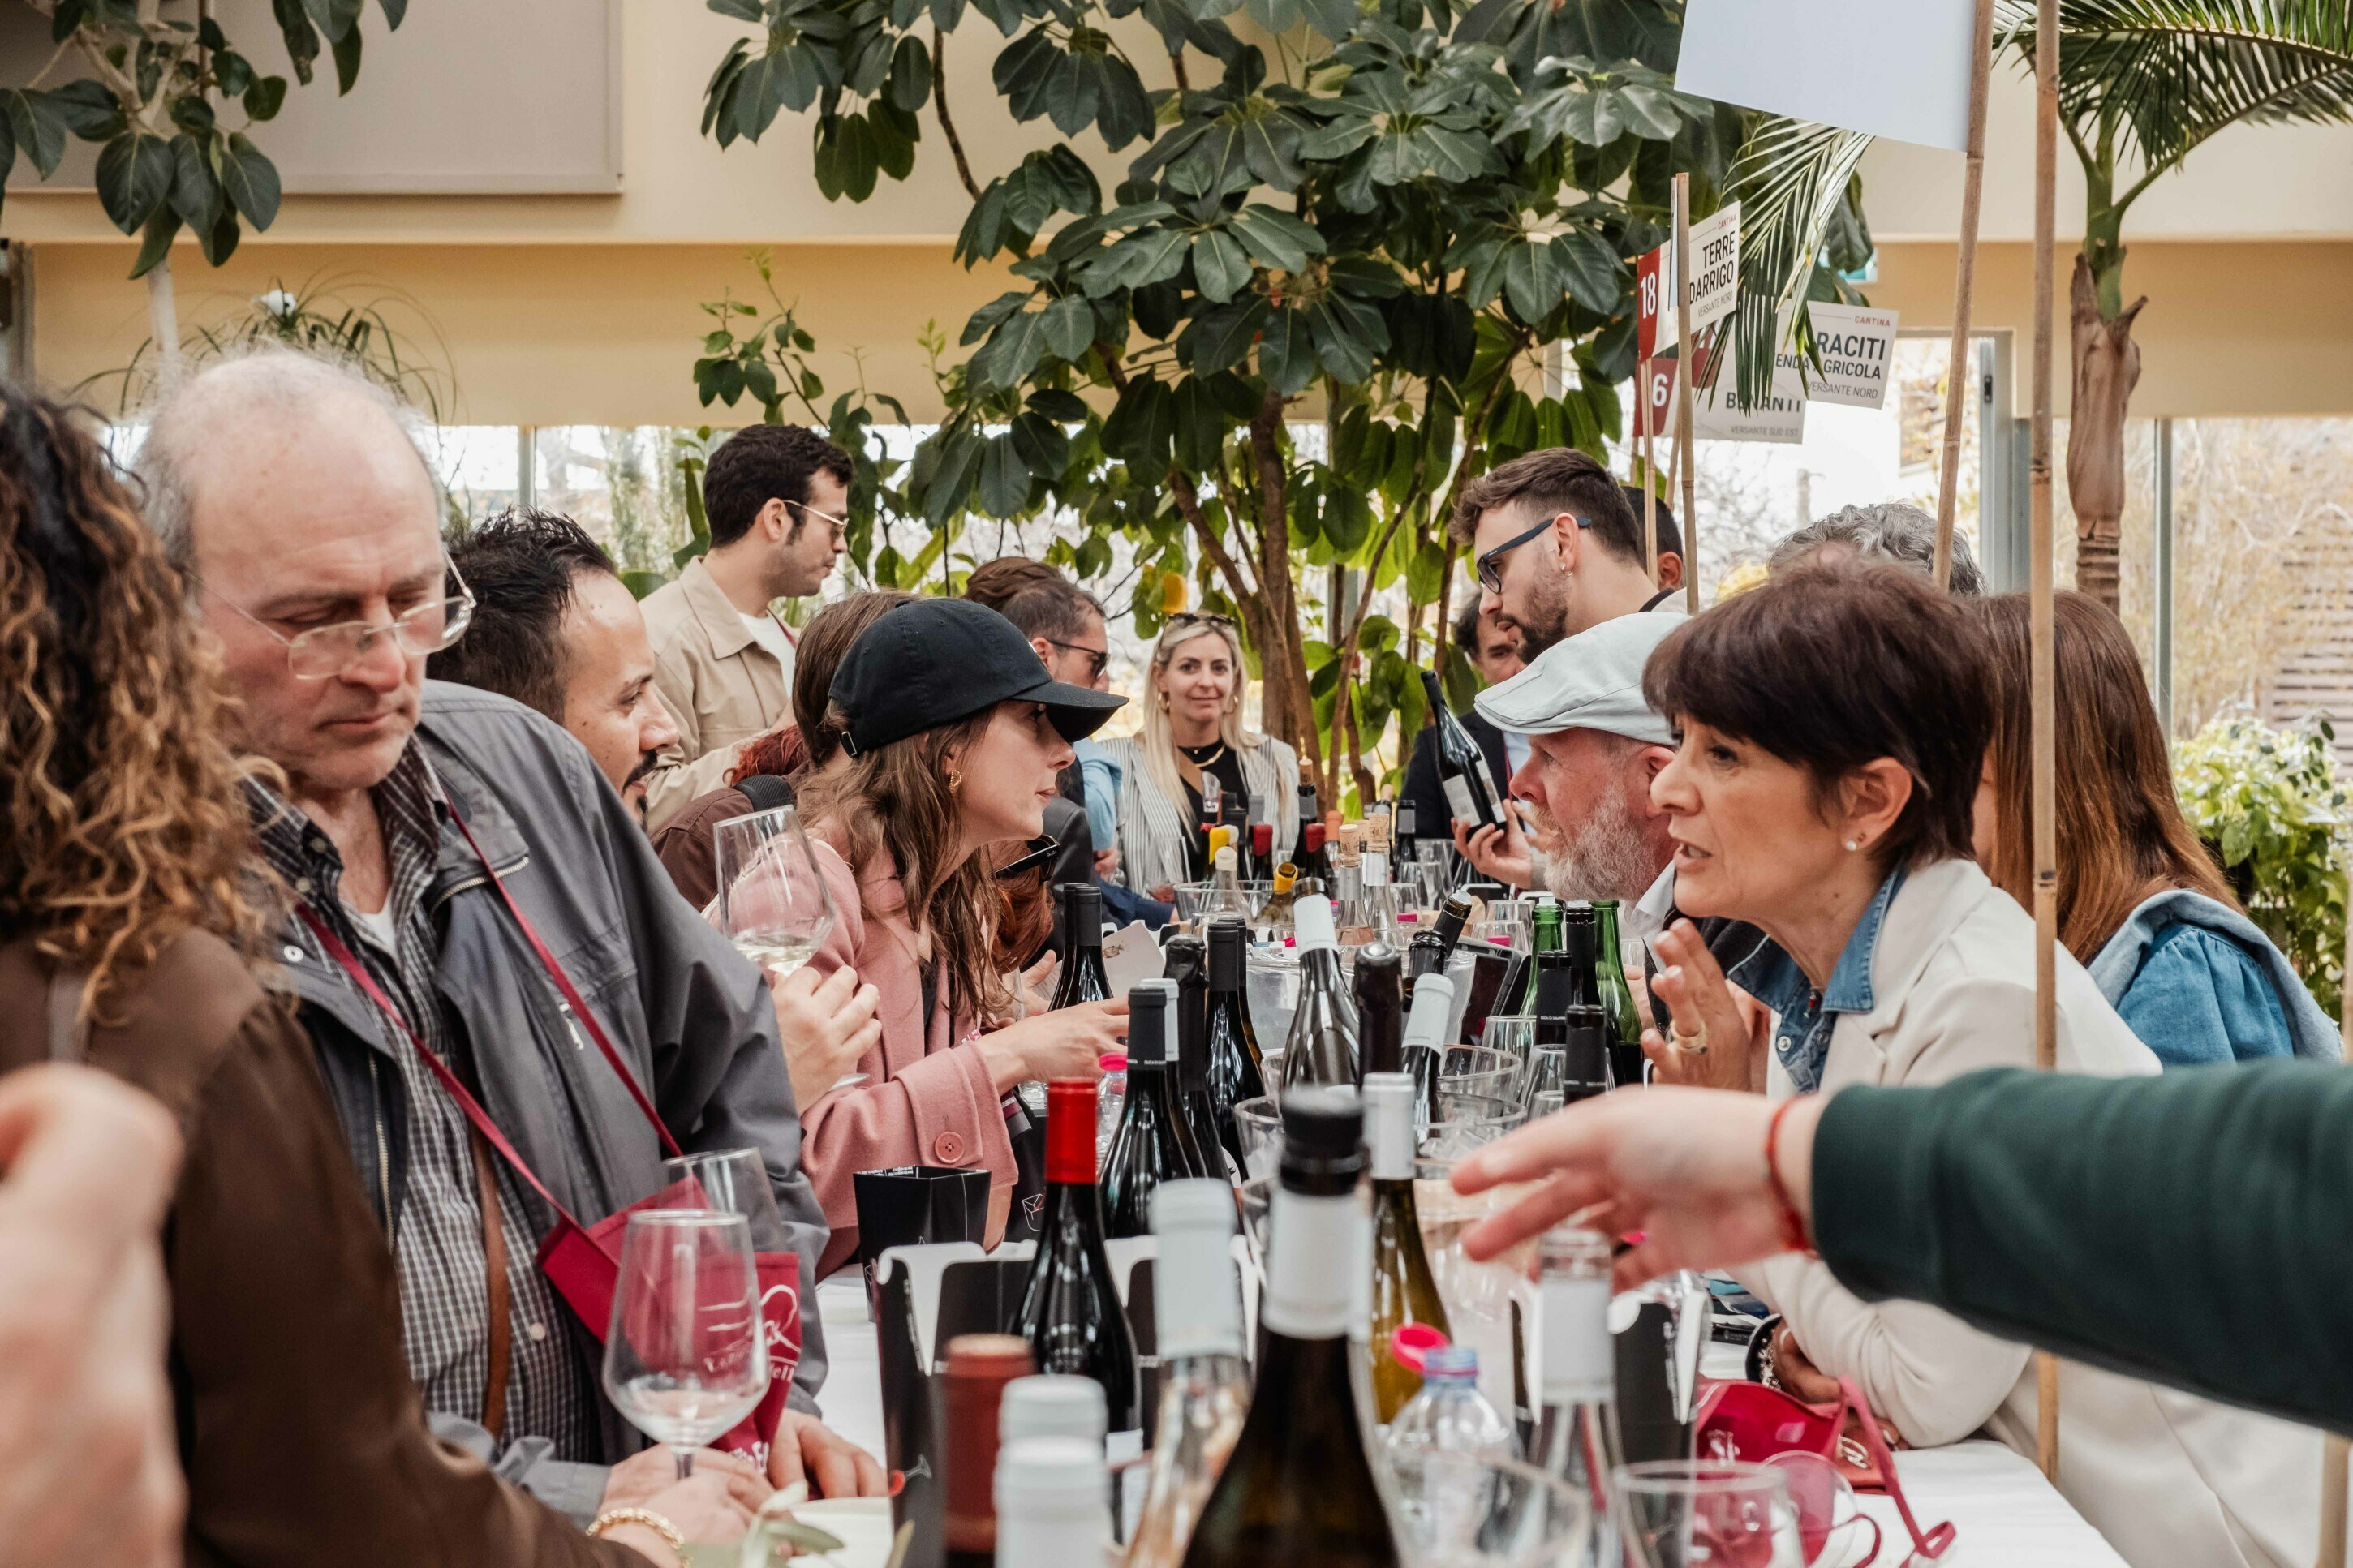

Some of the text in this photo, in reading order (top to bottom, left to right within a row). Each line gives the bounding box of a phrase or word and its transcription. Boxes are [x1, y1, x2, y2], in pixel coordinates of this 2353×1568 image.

[1718, 214, 1736, 230] CANTINA
[1702, 230, 1736, 268] TERRE
[1641, 272, 1656, 319] 18
[1689, 260, 1734, 305] DARRIGO
[1697, 291, 1733, 317] VERSANTE NORD
[1855, 316, 1891, 327] CANTINA
[1817, 332, 1886, 361] RACITI
[1808, 381, 1878, 399] VERSANTE NORD
[1731, 426, 1799, 437] VERSANTE SUD EST
